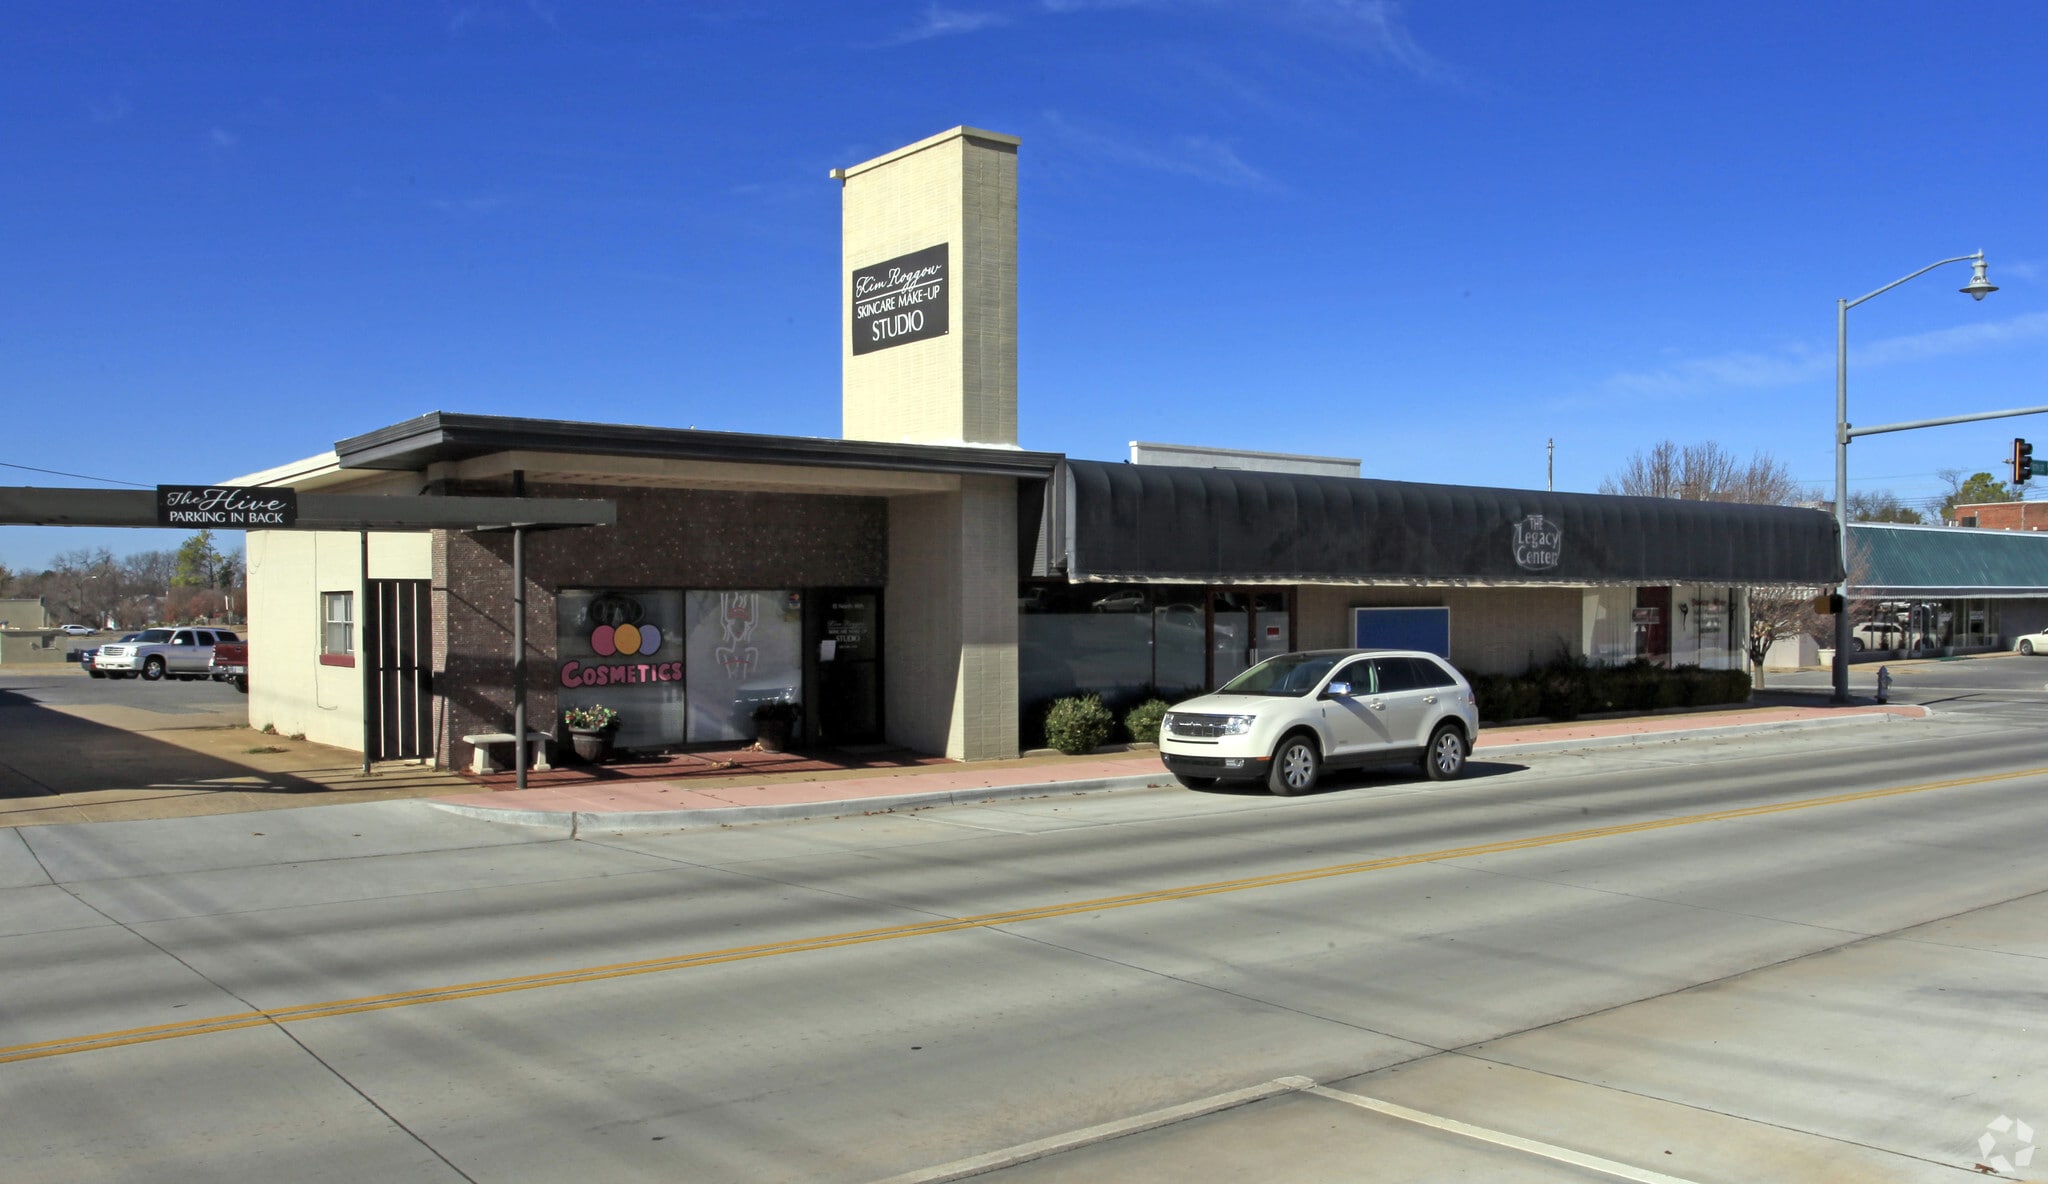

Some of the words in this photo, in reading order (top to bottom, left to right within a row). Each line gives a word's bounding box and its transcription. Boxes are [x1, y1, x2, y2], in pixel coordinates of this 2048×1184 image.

[856, 276, 887, 298] Kim
[886, 264, 942, 294] Roggow
[857, 297, 896, 319] SKINCARE
[898, 285, 940, 308] MAKE-UP
[872, 309, 924, 341] STUDIO
[167, 490, 201, 506] The
[199, 488, 287, 511] Hive
[169, 511, 226, 523] PARKING
[230, 512, 245, 523] IN
[249, 512, 283, 524] BACK
[1514, 523, 1559, 550] Legacy
